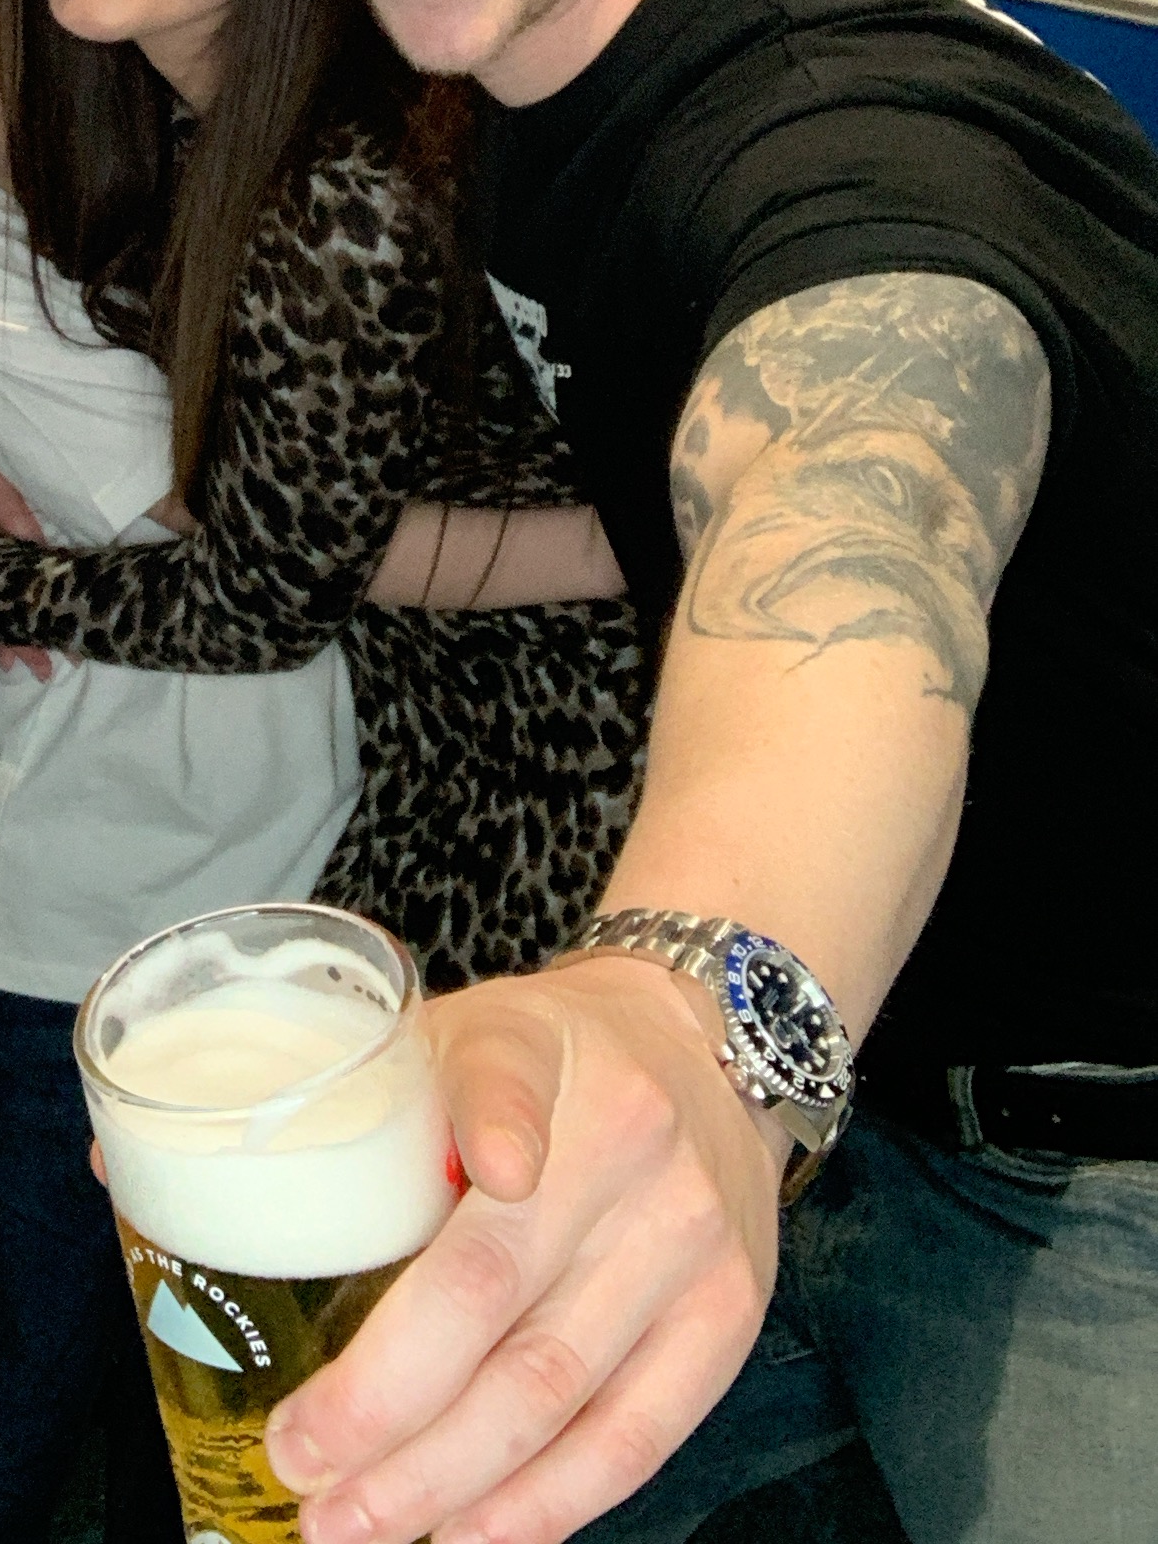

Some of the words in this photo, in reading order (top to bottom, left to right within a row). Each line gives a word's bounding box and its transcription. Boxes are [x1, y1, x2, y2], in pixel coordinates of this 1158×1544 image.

[731, 943, 747, 959] 10
[728, 971, 741, 985] 8
[145, 1248, 183, 1277] THE
[193, 1273, 271, 1368] ROCKIES
